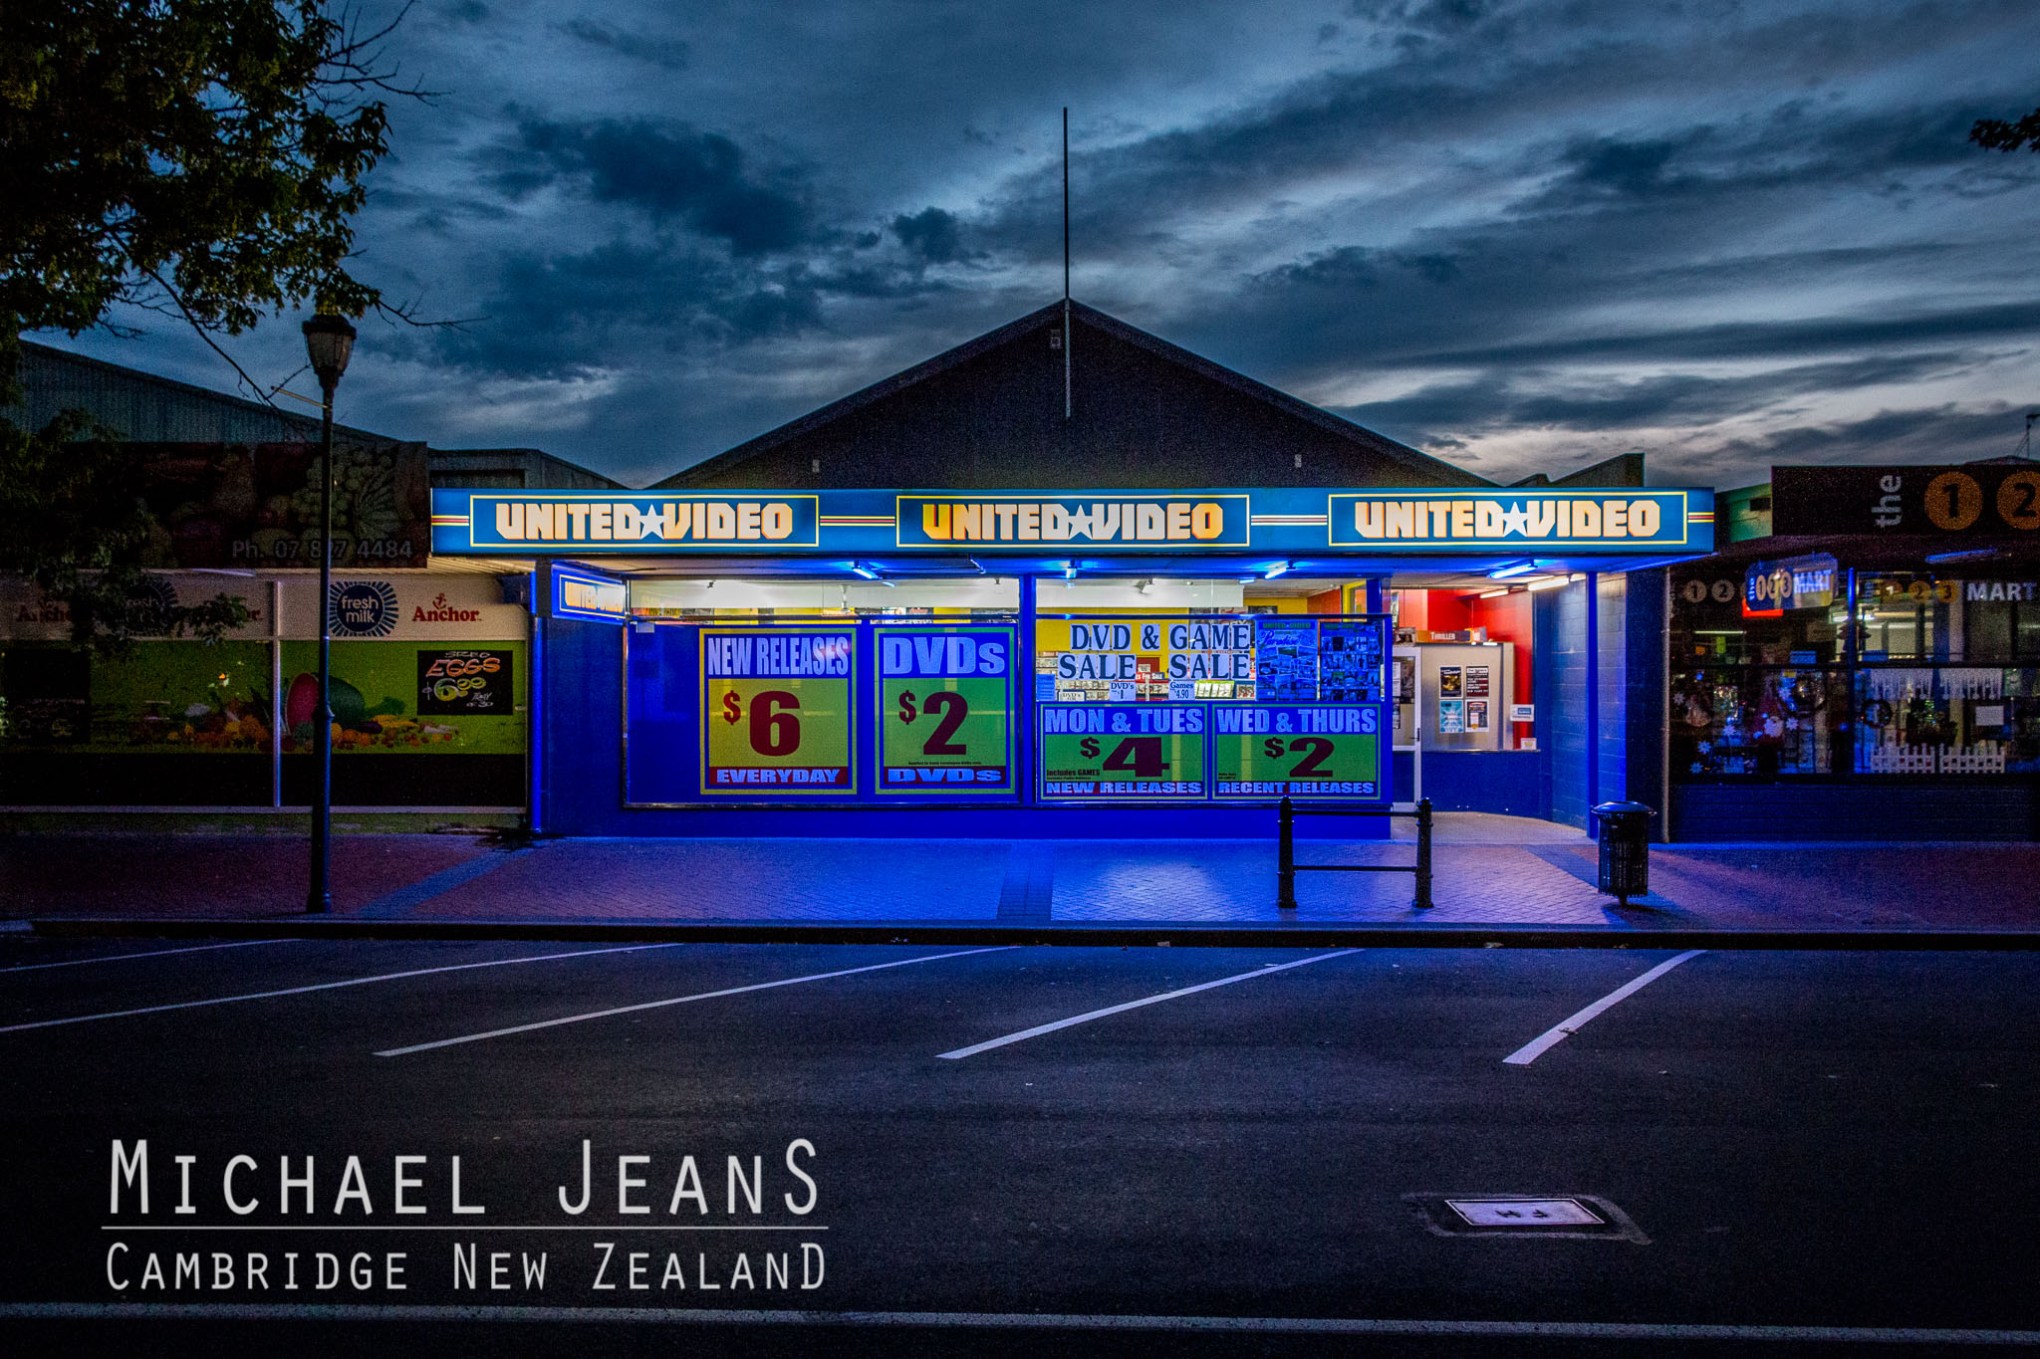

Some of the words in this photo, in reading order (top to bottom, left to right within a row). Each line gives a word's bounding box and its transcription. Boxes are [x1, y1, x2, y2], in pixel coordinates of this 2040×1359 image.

[1871, 475, 1902, 528] the
[496, 503, 641, 540] UNITED
[663, 503, 793, 540] VIDEO
[922, 503, 1071, 540] UNITED
[1091, 503, 1224, 540] VIDEO
[1354, 500, 1504, 538] UNITED
[1526, 500, 1661, 537] VIDEO
[232, 541, 265, 559] Ph.
[309, 540, 348, 559] 87
[356, 540, 414, 559] 4484
[340, 594, 379, 609] fresh
[1967, 582, 2037, 601] MART
[344, 609, 375, 623] milk
[412, 606, 479, 622] Anchor
[1071, 624, 1130, 650] DVD
[1141, 624, 1160, 650] &
[1169, 624, 1251, 650] GAME
[708, 637, 752, 675] NEW
[756, 637, 849, 675] RELEASES
[883, 637, 1005, 674] DVDs
[1060, 654, 1136, 679] SALE
[1169, 653, 1251, 679] SALE
[425, 657, 501, 678] EGGS
[1044, 709, 1105, 733] MON
[1111, 712, 1131, 733] &
[1136, 708, 1203, 733] TUES
[1217, 709, 1270, 733] WED
[1275, 712, 1293, 733] &
[1297, 708, 1377, 733] THURS
[716, 768, 840, 783] EVERYDAY
[887, 768, 1002, 783] DVDs
[1046, 782, 1096, 794] NEW
[1099, 782, 1202, 794] RELEASES
[1218, 782, 1287, 794] RECENT
[1289, 782, 1374, 794] RELEASES
